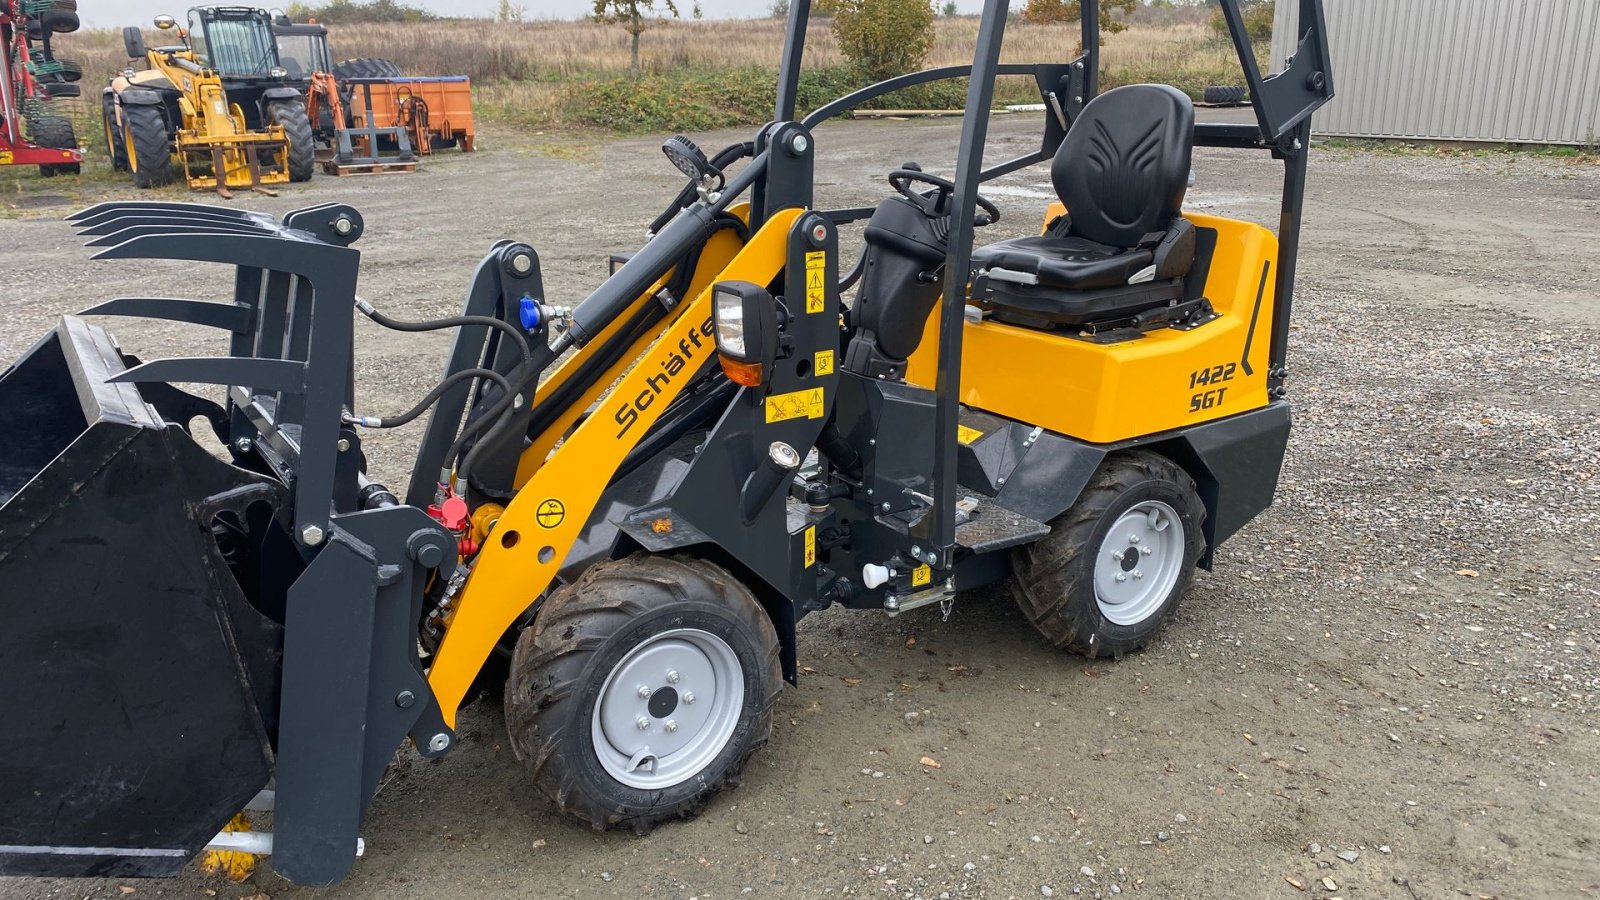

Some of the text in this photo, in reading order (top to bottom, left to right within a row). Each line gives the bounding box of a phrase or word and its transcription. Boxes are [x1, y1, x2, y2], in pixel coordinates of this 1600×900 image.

[615, 316, 713, 440] Schäffe
[1189, 362, 1236, 389] 1422
[1189, 387, 1228, 413] SGT
